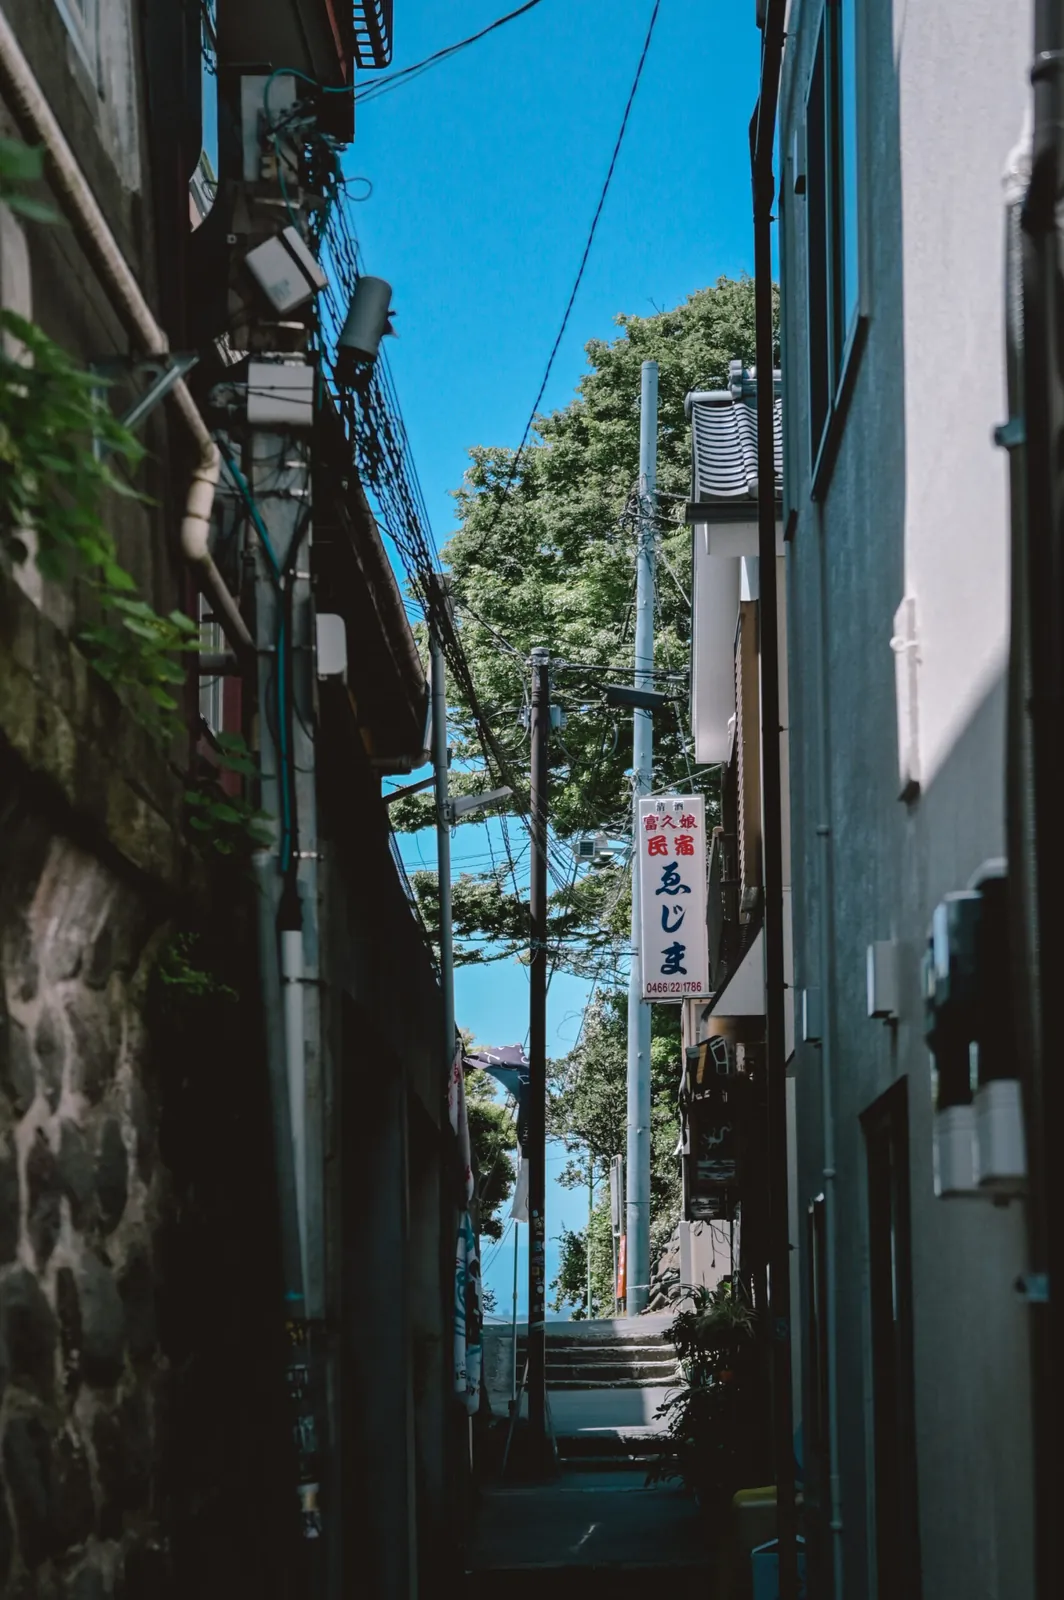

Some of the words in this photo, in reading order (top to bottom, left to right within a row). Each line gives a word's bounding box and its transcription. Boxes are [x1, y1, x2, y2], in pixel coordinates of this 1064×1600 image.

[656, 802, 684, 812] 清酒
[643, 814, 698, 831] 富久娘
[648, 834, 694, 857] 民宿
[655, 861, 692, 976] ゑじま
[646, 981, 702, 993] 0466(22)1786
